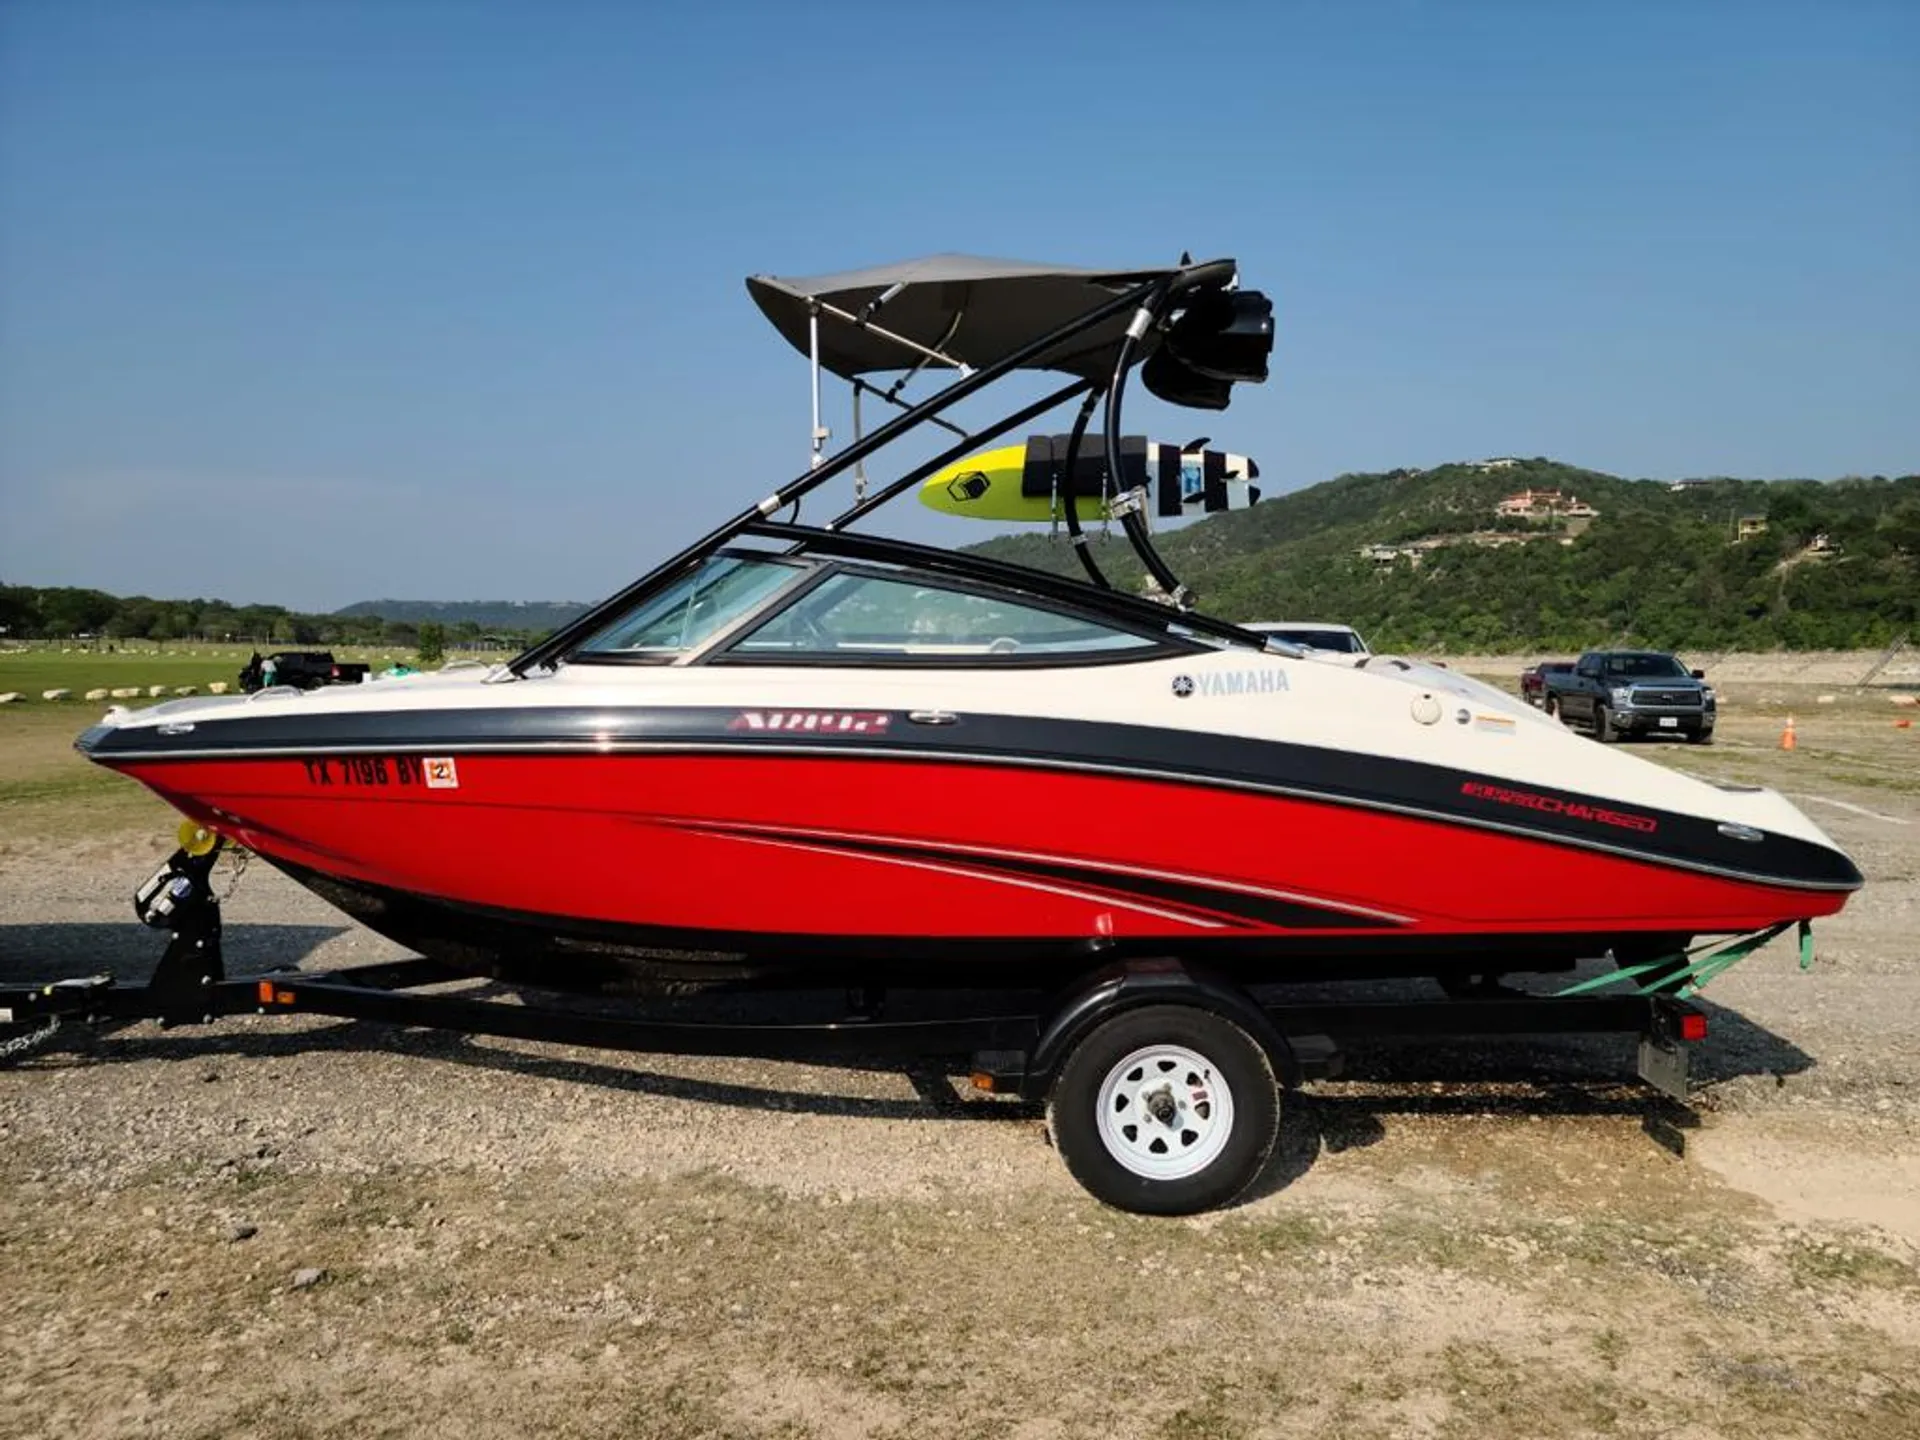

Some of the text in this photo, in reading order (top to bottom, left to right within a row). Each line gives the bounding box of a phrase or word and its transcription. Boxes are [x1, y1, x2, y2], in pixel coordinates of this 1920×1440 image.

[1197, 668, 1290, 696] YAMAHA
[304, 756, 422, 785] TX 7196 BY
